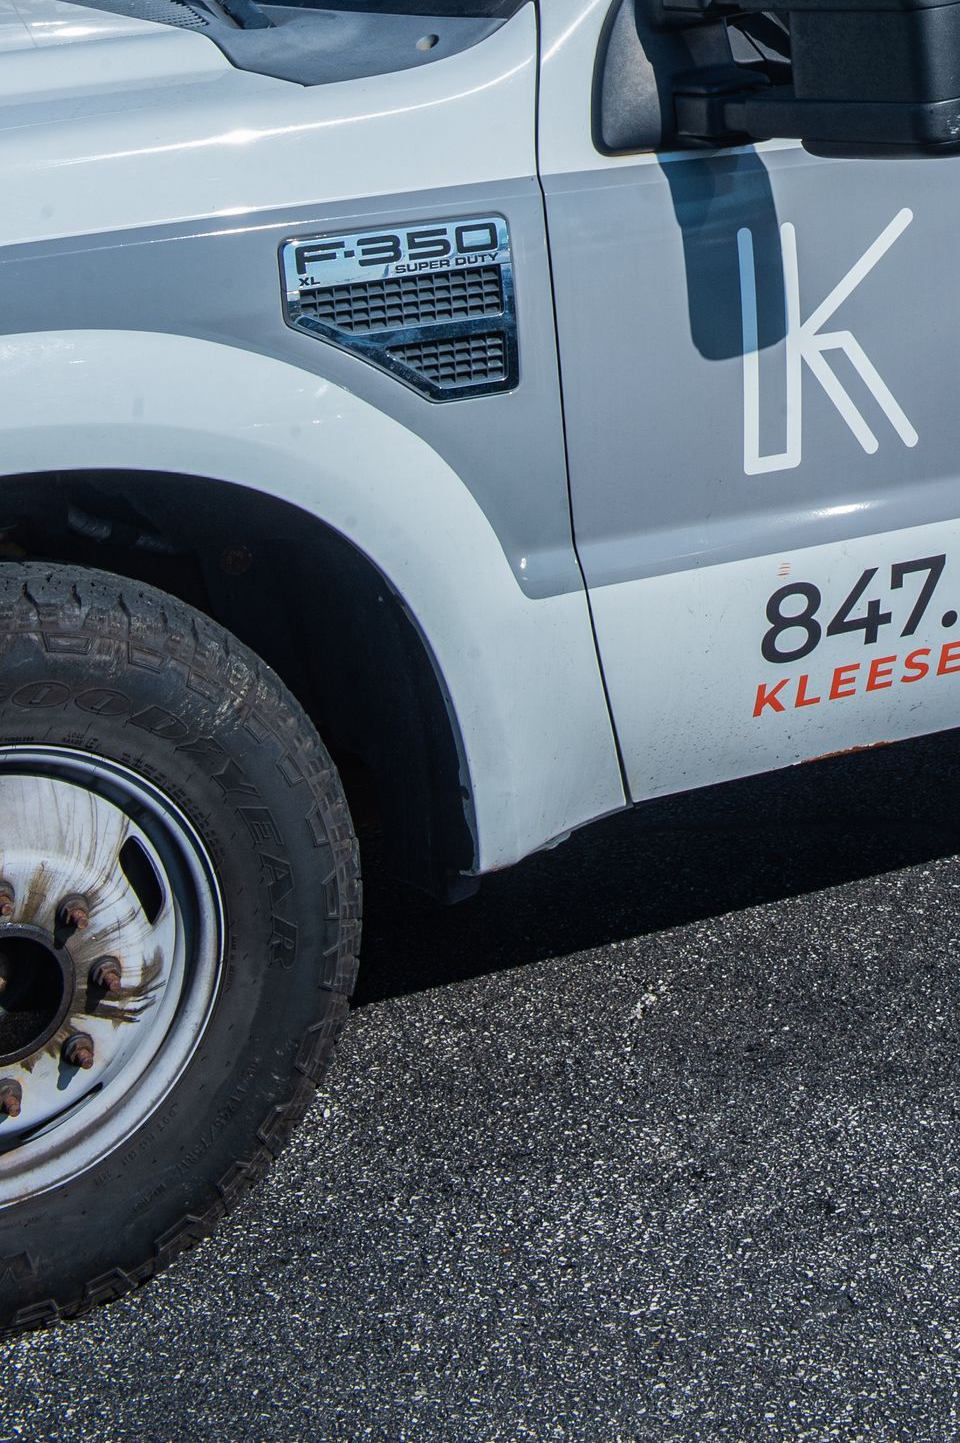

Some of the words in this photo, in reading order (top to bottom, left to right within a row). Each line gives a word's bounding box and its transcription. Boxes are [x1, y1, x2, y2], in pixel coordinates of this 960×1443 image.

[395, 259, 451, 274] SUPER
[455, 252, 499, 267] DUTY
[298, 277, 320, 287] XL
[0, 682, 299, 969] OODYEAR
